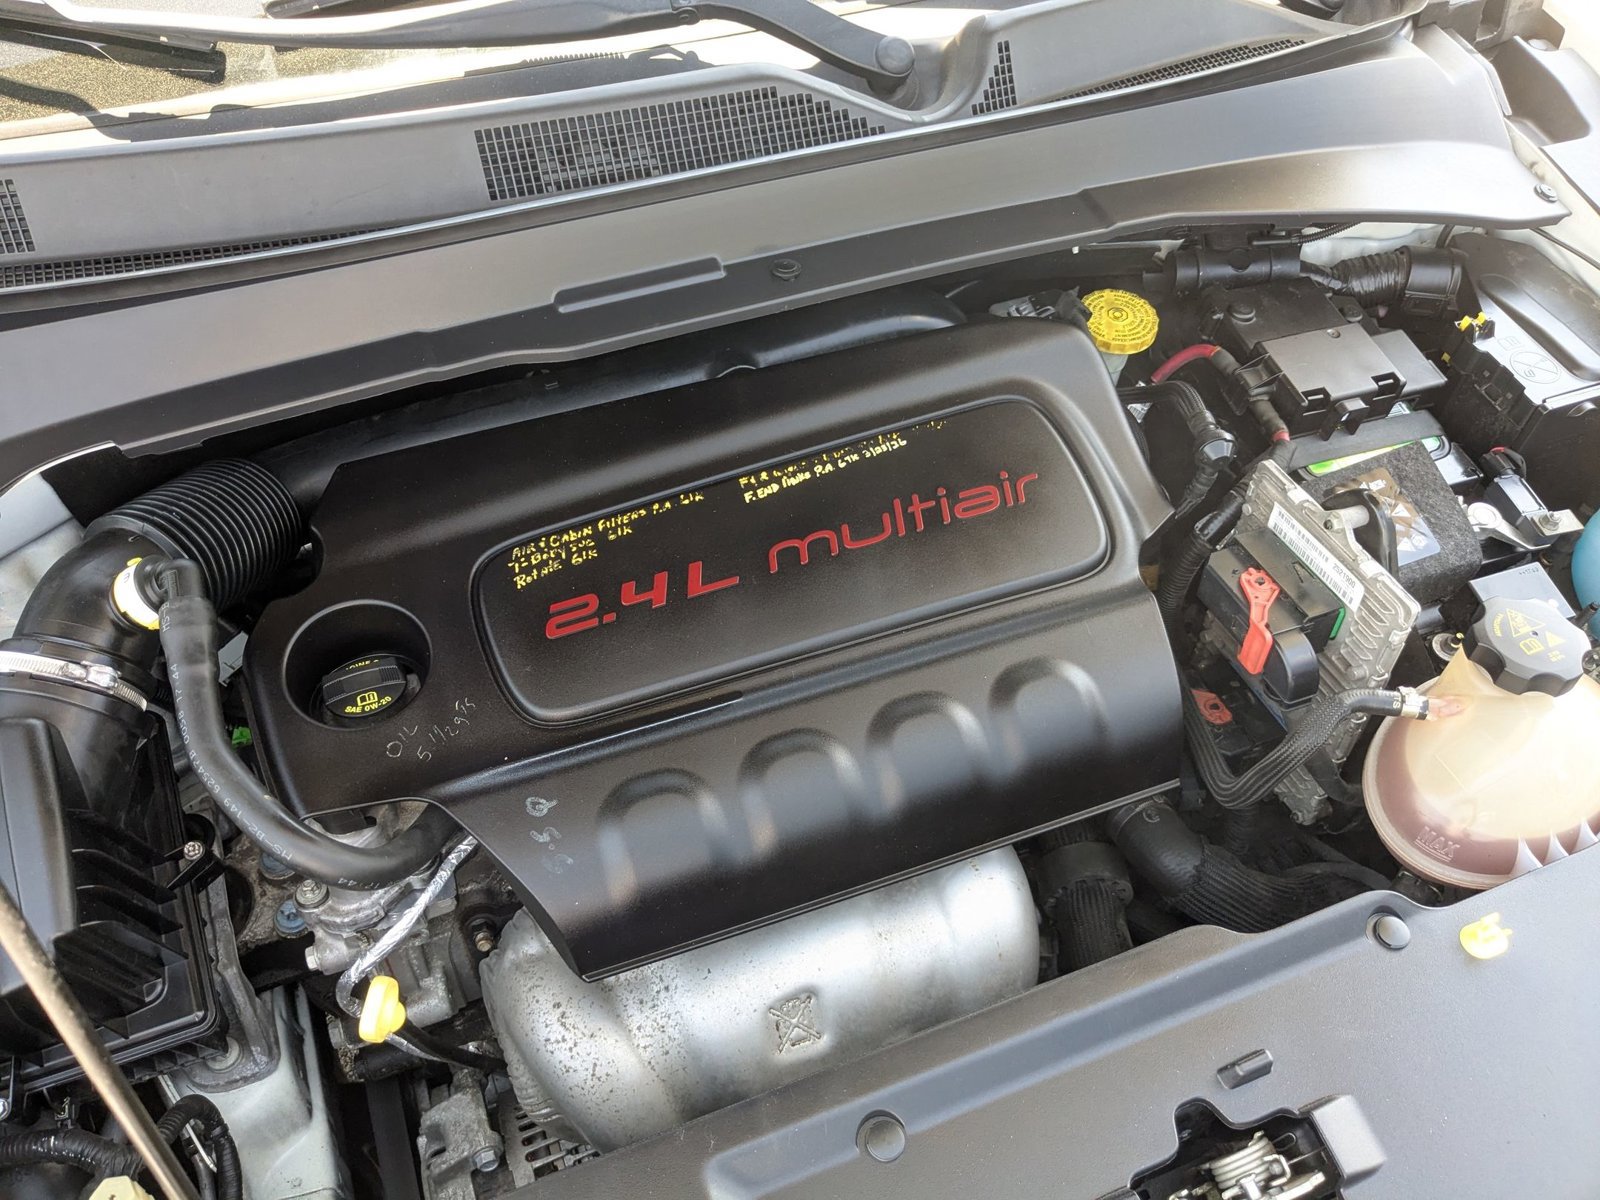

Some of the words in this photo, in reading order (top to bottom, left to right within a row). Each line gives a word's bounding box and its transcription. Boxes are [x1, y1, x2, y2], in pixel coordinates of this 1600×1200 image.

[768, 471, 1039, 574] multiair
[364, 696, 392, 711] 0W-20
[386, 725, 418, 758] OIL
[1416, 826, 1460, 858] MAX
